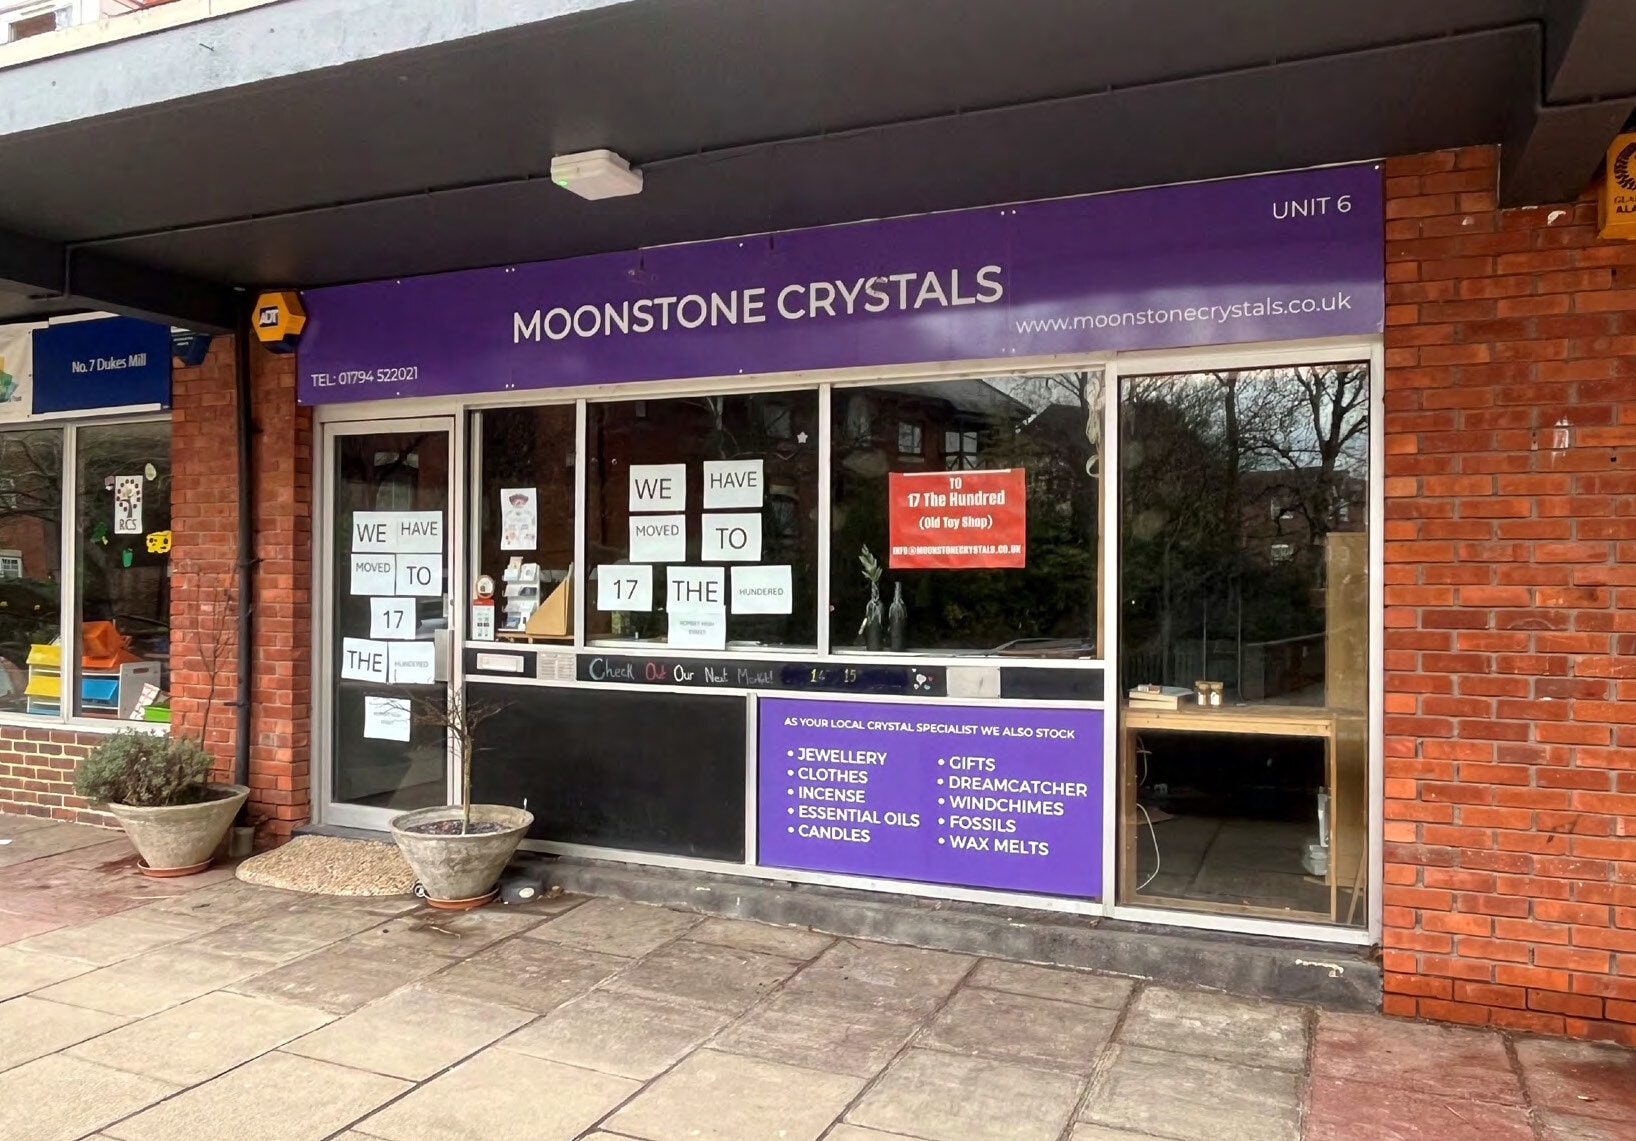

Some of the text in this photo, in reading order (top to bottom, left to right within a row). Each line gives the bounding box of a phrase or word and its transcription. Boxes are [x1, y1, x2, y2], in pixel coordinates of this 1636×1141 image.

[1273, 195, 1352, 220] UNIT 6
[512, 264, 1004, 344] MOONSTONE CRYSTALS
[1016, 292, 1352, 334] www.moonstonecrystals.co.uk
[259, 309, 279, 325] ADT
[71, 353, 147, 373] No. 7 Dukes Mill
[311, 366, 418, 387] TEL: 01794 522021
[635, 471, 758, 500] WE HAVE
[949, 477, 963, 490] TO
[907, 489, 1006, 508] 17 The Hundred
[119, 518, 137, 531] RCS
[357, 521, 438, 543] WE HAVE
[919, 514, 993, 530] (Old Toy Shop)
[635, 524, 748, 550] MOVED TO
[355, 562, 431, 586] MOVED TO
[613, 579, 784, 603] 17 THE HUNDERED
[383, 610, 404, 629] 17
[347, 650, 383, 673] THE
[588, 657, 635, 681] Check
[673, 664, 695, 682] Our
[784, 718, 1075, 739] AS YOUR LOCAL CRYSTAL SPECIALIST WE ALSO STOCK
[797, 748, 887, 765] JEWELLERY
[949, 756, 996, 771] GIFTS
[797, 767, 868, 784] CLOTHES
[798, 786, 866, 803] INCENSE
[949, 776, 1088, 797] DREAMCATCHER
[798, 805, 920, 827] ESSENTIAL OILS
[950, 795, 1064, 816] WINDCHIMES
[798, 824, 870, 843] CANDLES
[950, 816, 1016, 833] FOSSILS
[950, 835, 1049, 856] WAX MELTS
